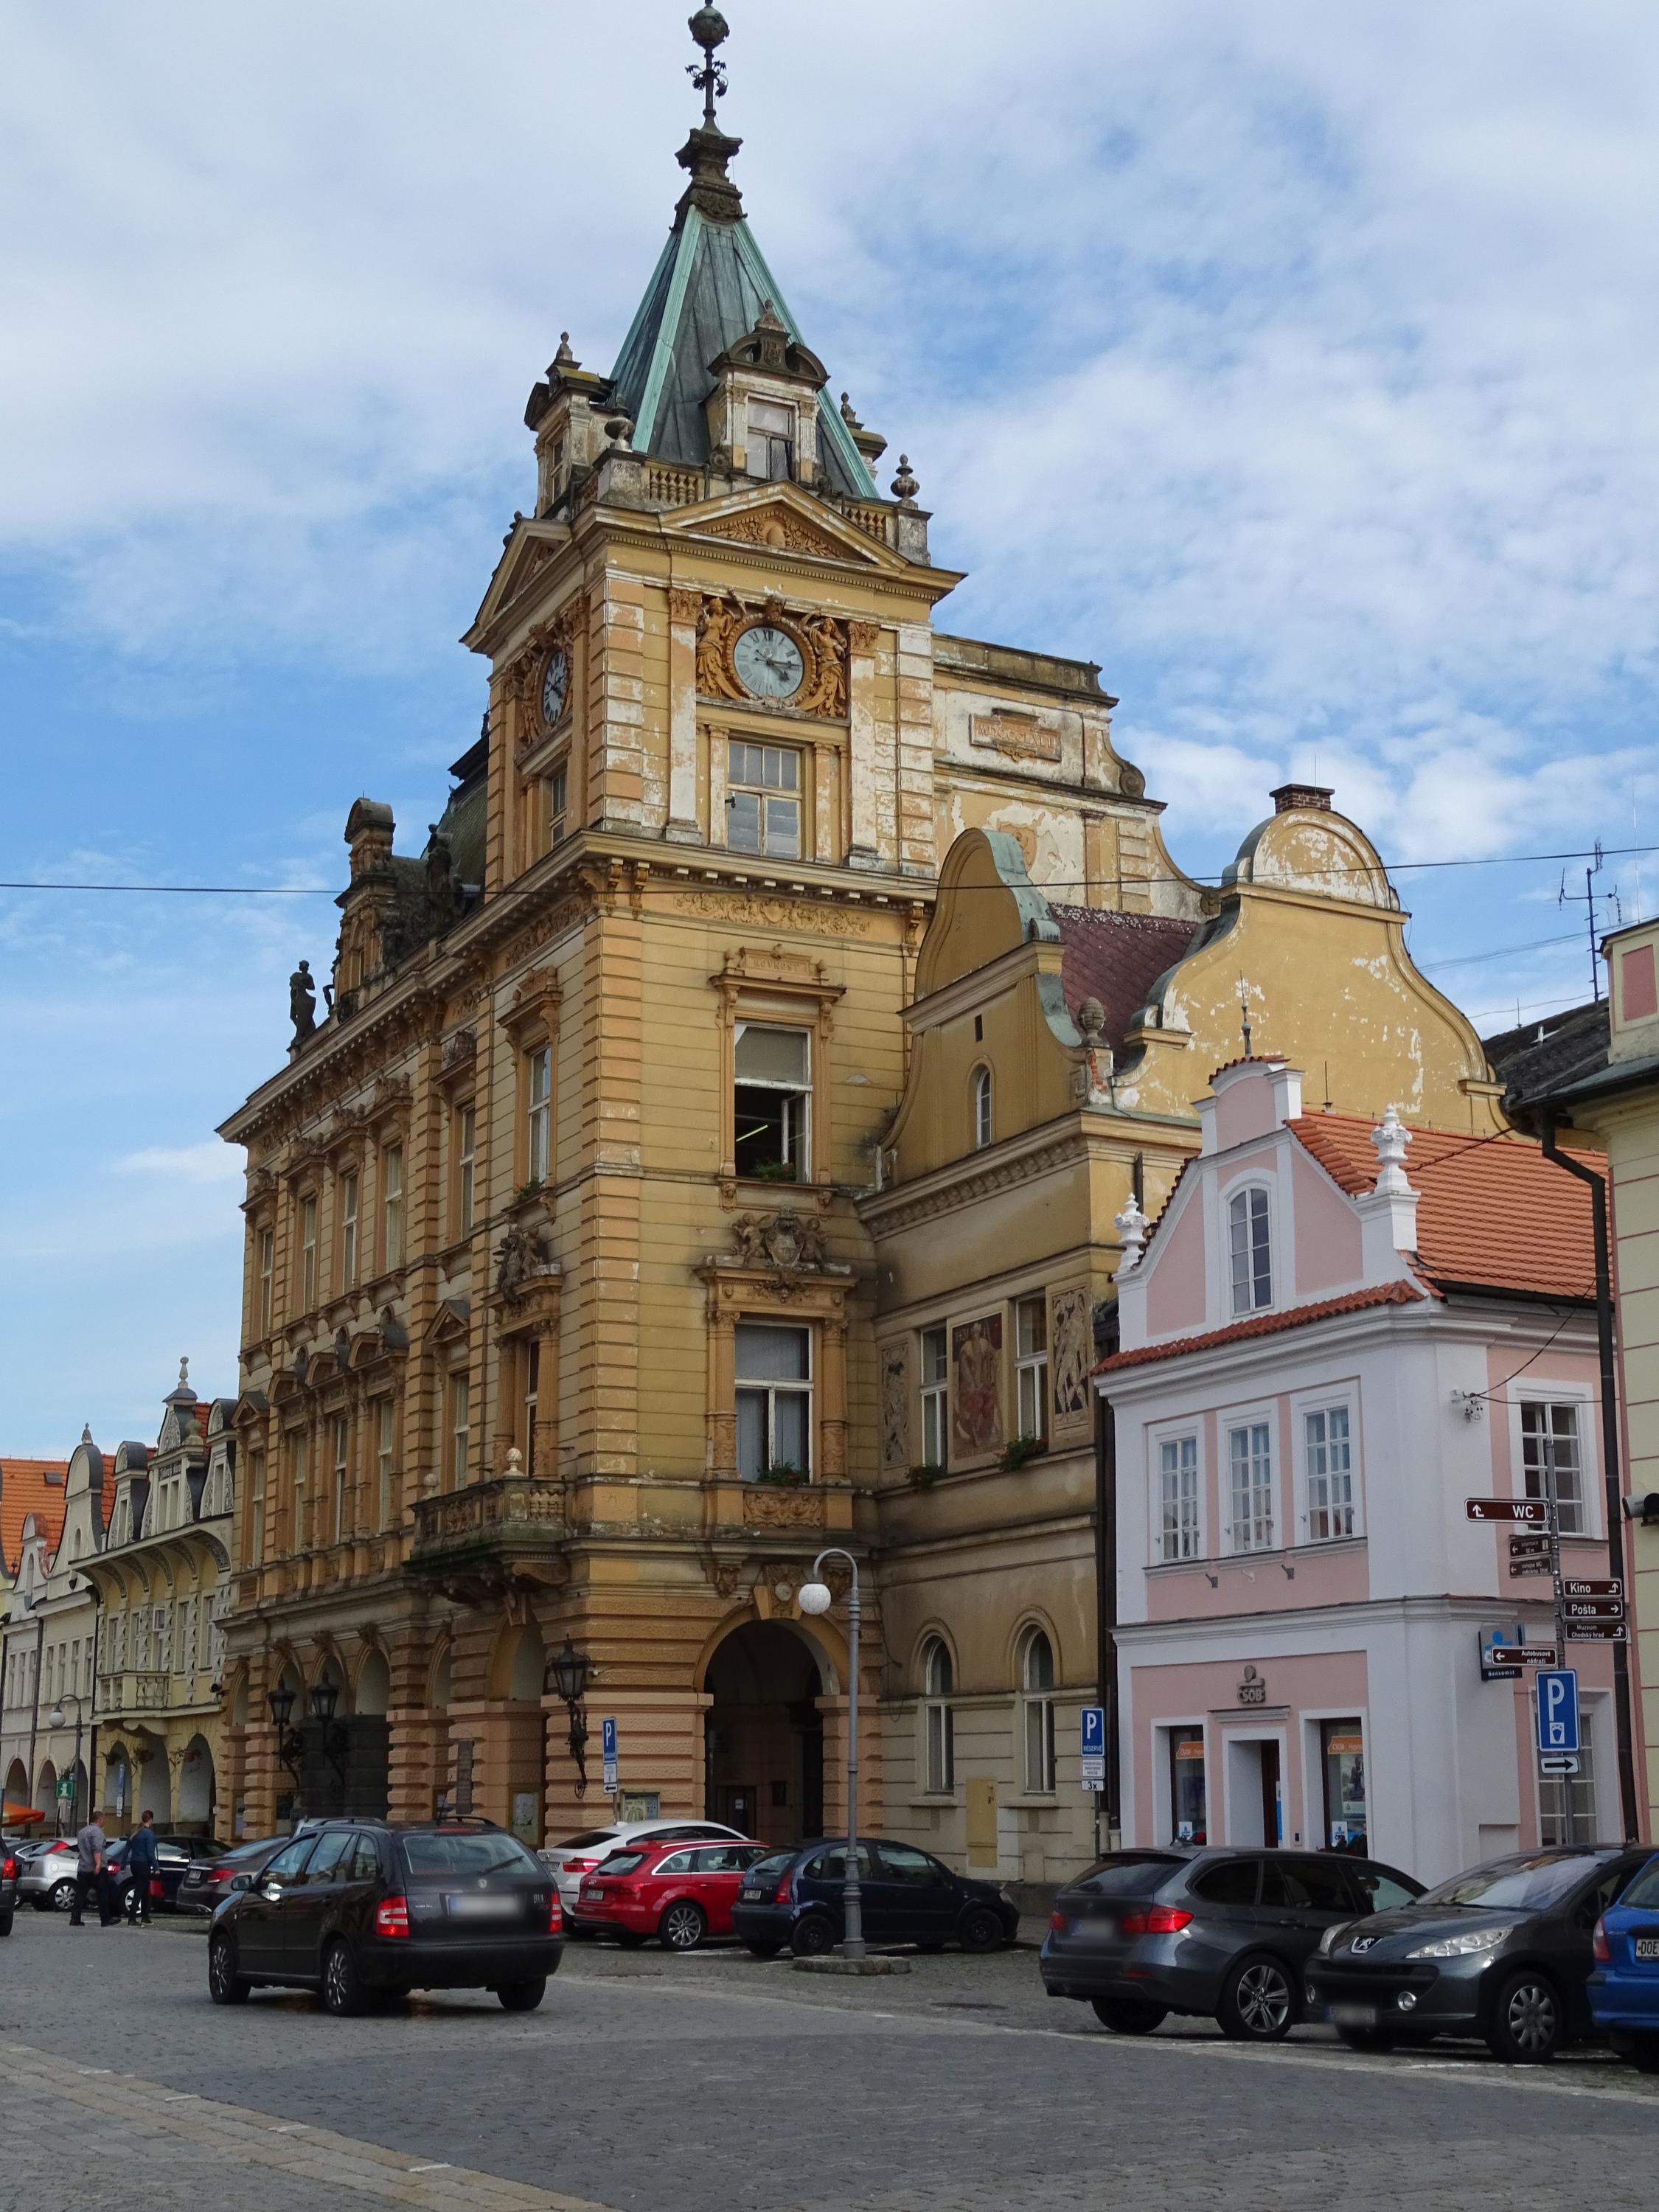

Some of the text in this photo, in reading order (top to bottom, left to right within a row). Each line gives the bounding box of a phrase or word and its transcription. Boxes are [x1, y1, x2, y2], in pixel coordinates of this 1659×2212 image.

[1512, 1505, 1534, 1519] WC
[1570, 1582, 1591, 1593] Kino
[1571, 1604, 1596, 1615] Pošta
[1571, 1631, 1592, 1639] Chodský
[1547, 1678, 1565, 1722] P
[1087, 1713, 1097, 1739] P
[605, 1722, 612, 1746] P
[1088, 1781, 1097, 1790] 3x
